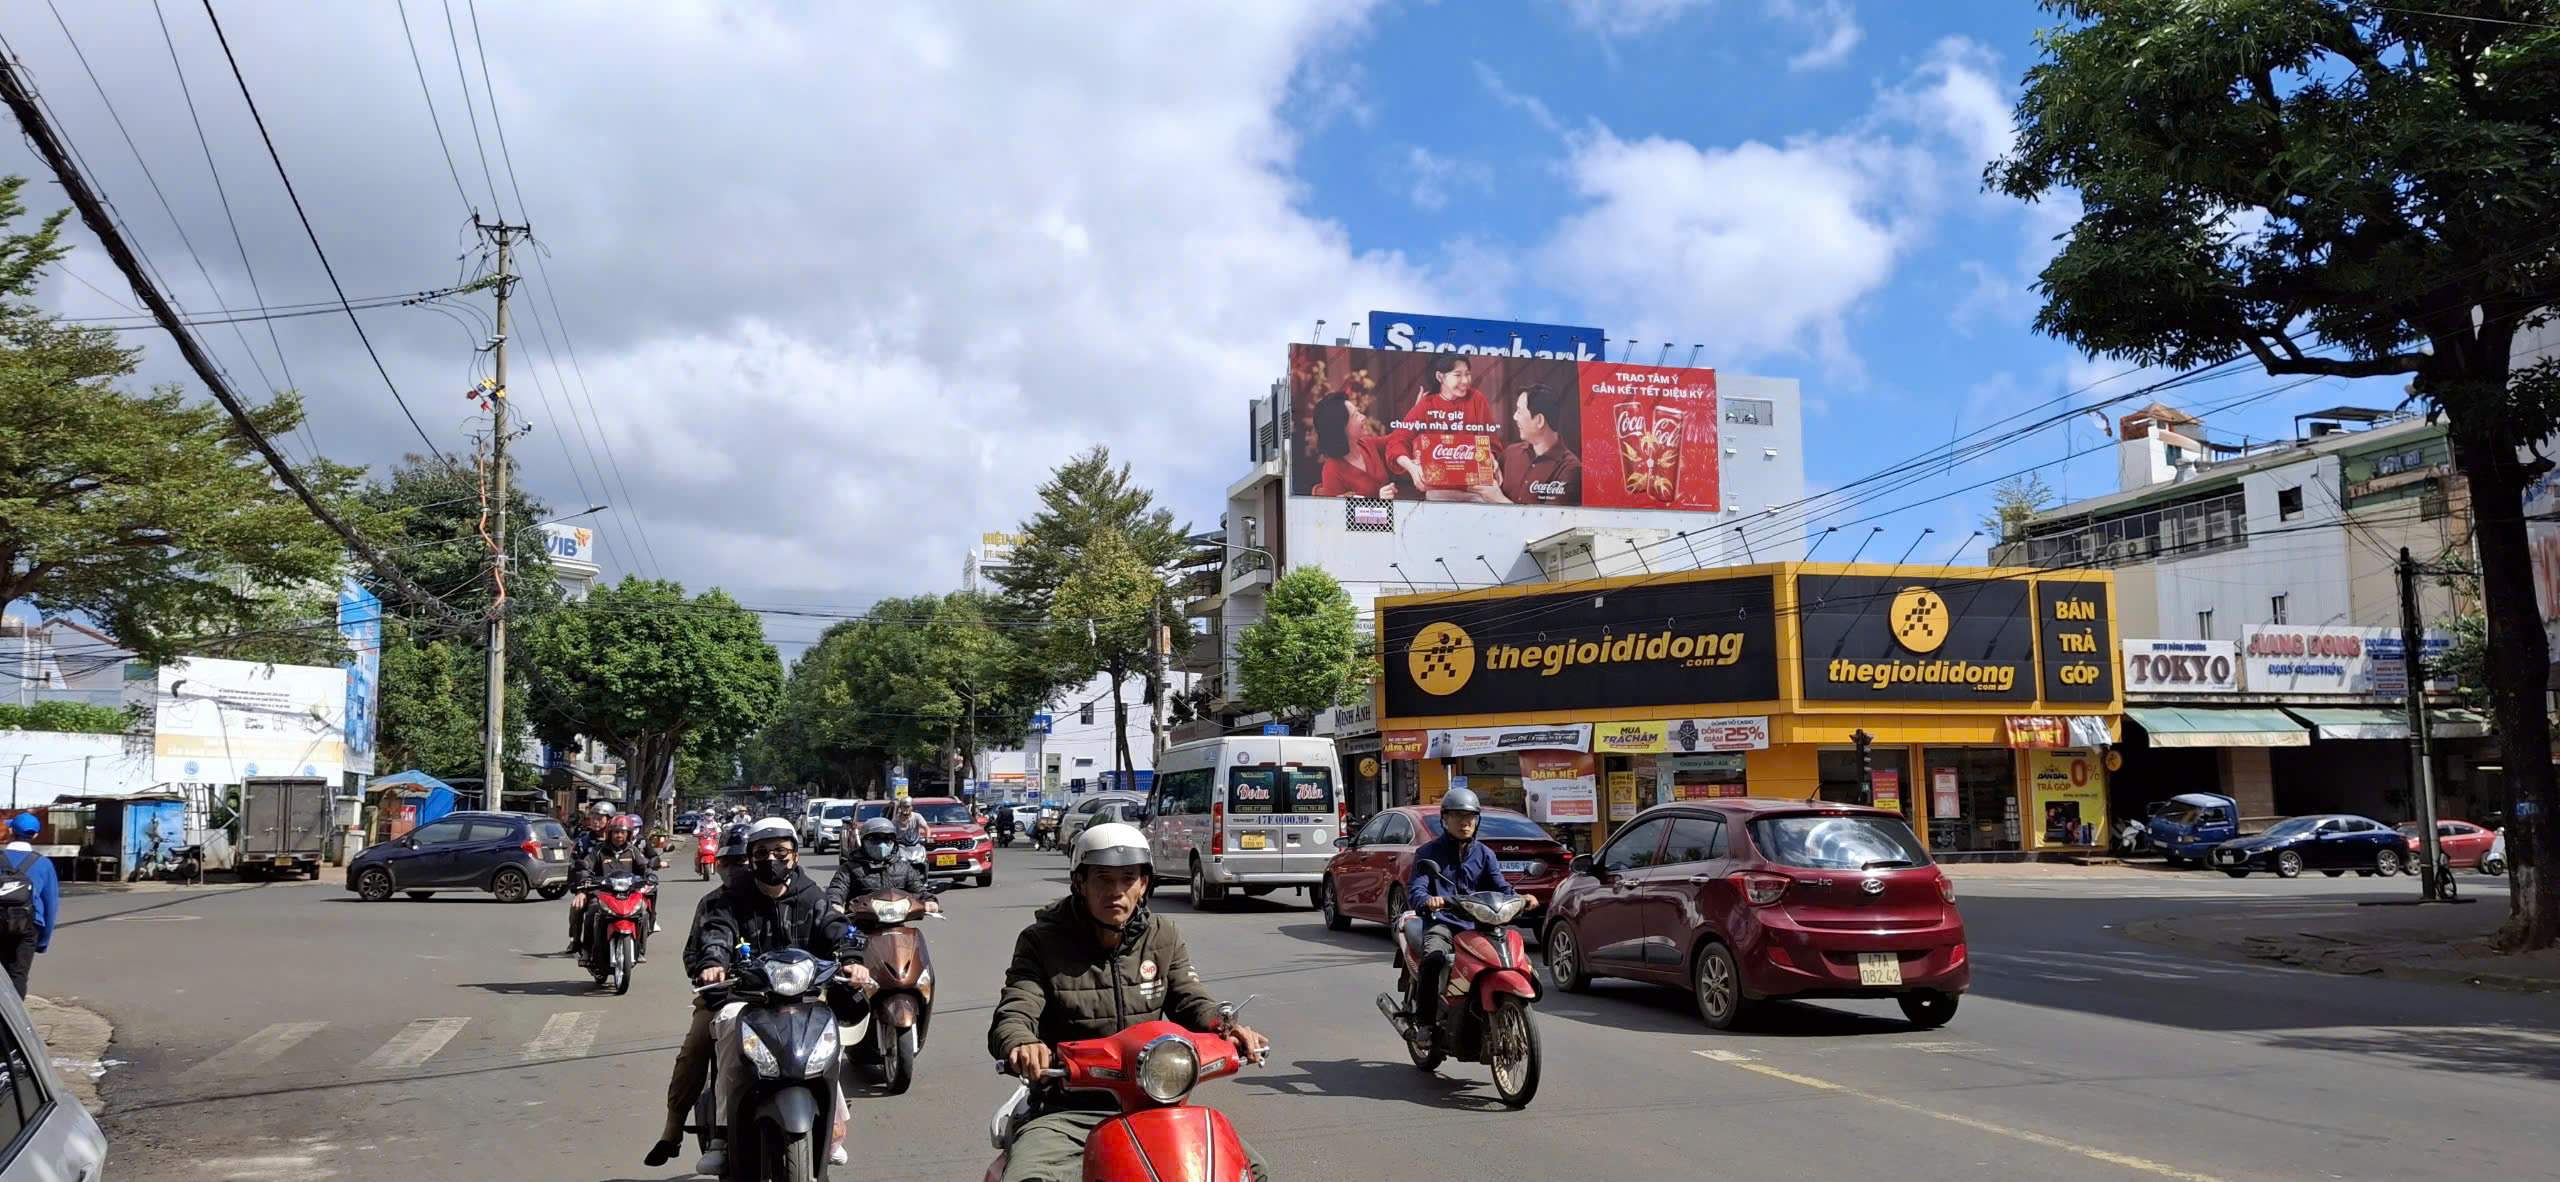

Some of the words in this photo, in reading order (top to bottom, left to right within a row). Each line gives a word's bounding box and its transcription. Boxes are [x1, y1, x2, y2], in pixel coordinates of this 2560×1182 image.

[1616, 372, 1645, 383] TRAO
[1647, 372, 1669, 384] TÂM
[1672, 375, 1680, 384] Ý
[1617, 384, 1638, 395] KẾT
[1640, 384, 1660, 396] TẾT
[1390, 420, 1427, 432] chuyện
[1429, 421, 1449, 431] nhà
[1450, 421, 1464, 431] để
[1466, 423, 1484, 432] con
[544, 535, 578, 556] VIB
[2056, 597, 2095, 620] BÁN
[2060, 627, 2096, 652] TRẢ
[1486, 631, 1744, 676] thegioididong
[1681, 657, 1715, 668] .com
[1829, 659, 2016, 691] thegioididong
[2060, 662, 2099, 684] GÓP
[2129, 654, 2231, 685] TOKYO
[1335, 708, 1354, 728] MINH
[1355, 704, 1371, 723] ANH
[1620, 726, 1641, 735] MUA
[1724, 726, 1765, 742] 25%
[1868, 953, 1889, 967] 47A
